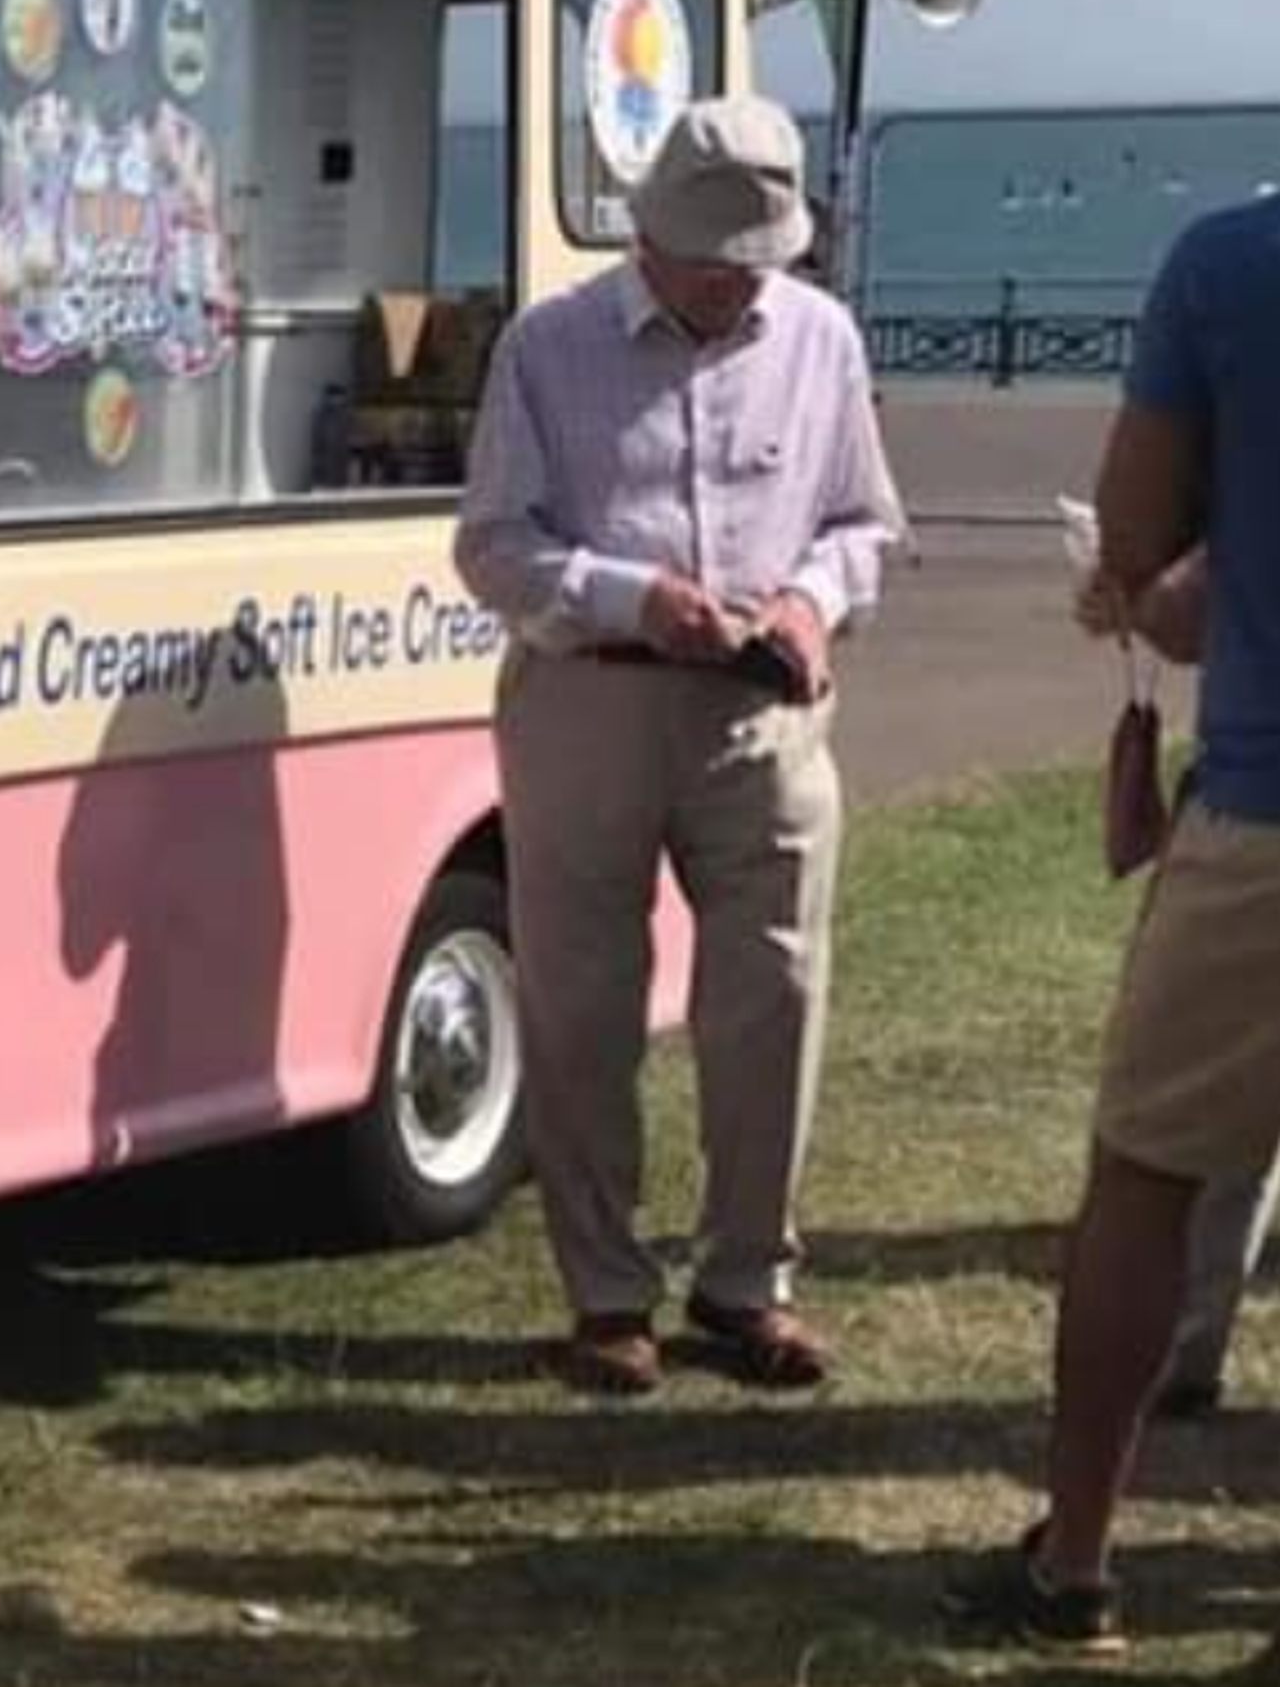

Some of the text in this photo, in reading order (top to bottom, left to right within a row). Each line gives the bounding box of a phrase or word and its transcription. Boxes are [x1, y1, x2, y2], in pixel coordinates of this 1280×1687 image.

[36, 614, 217, 711] Creamy
[228, 593, 318, 682] Soft
[328, 591, 392, 671] Ice
[401, 584, 502, 664] Crea
